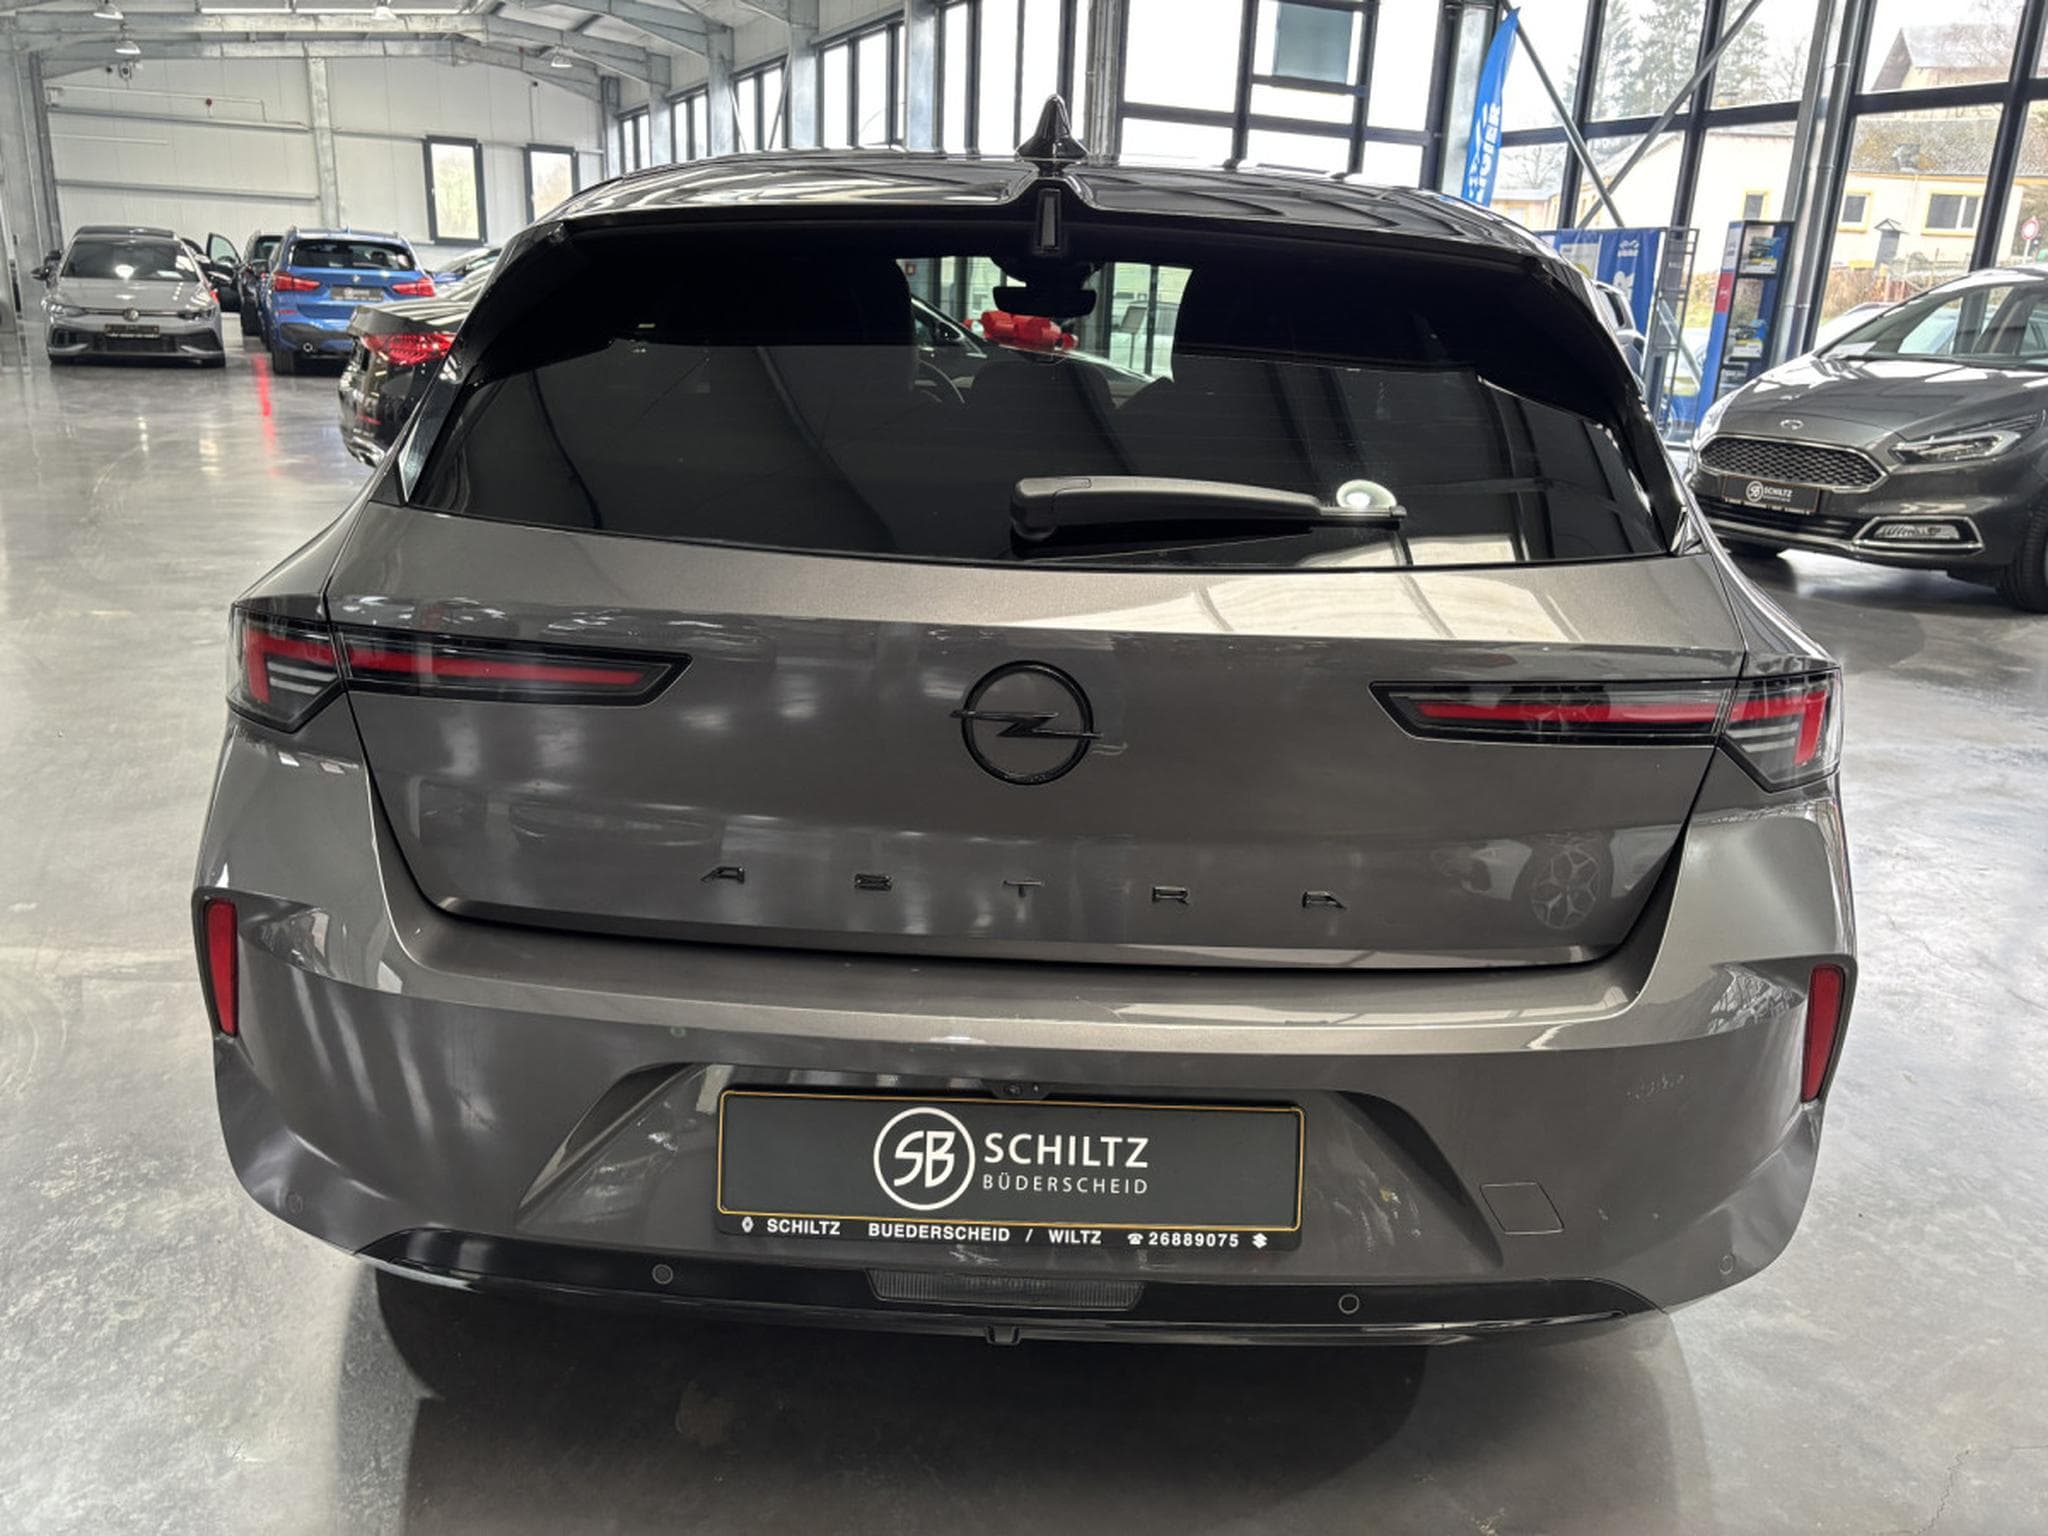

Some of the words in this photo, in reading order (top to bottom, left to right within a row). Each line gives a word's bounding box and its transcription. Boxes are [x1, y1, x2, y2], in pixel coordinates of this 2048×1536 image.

[893, 1129, 956, 1188] SB
[983, 1132, 1150, 1169] SCHILTZ
[982, 1172, 1149, 1195] BÜDERSCHEID
[766, 1218, 841, 1236] SCHILTZ
[868, 1222, 1011, 1243] BUEDERSCHEID
[1048, 1228, 1102, 1245] WILTZ
[1148, 1230, 1240, 1249] 26889075
